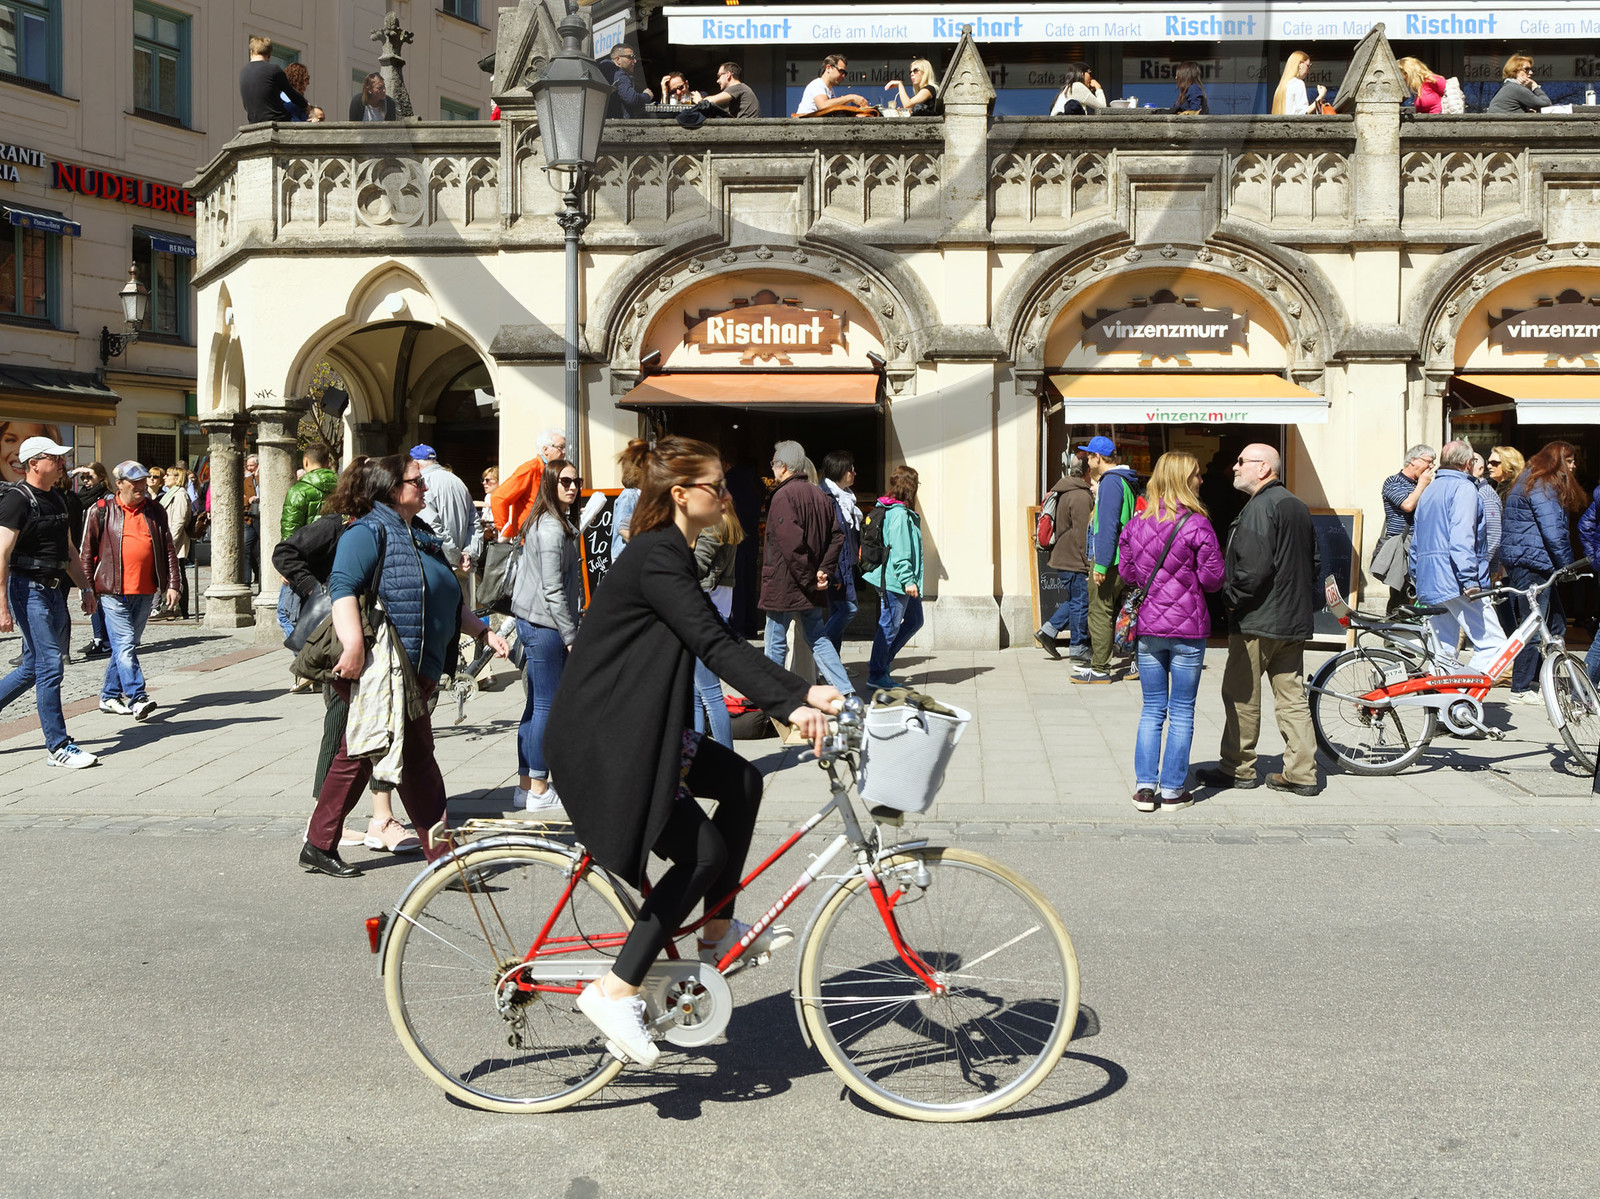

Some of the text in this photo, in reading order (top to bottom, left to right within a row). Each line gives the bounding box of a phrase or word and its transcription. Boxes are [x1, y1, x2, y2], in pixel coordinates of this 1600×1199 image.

[702, 18, 793, 40] Rischart
[846, 28, 866, 38] am
[871, 24, 908, 38] Markt
[1079, 25, 1100, 36] am
[1104, 22, 1142, 36] Markt
[1165, 14, 1257, 36] Rischart
[1317, 24, 1338, 35] am
[1406, 13, 1498, 35] Rischart
[1554, 22, 1575, 34] am
[169, 244, 196, 256] BERNI'S
[706, 316, 824, 345] Rischart
[1102, 320, 1229, 339] vinzenzmurr
[1146, 409, 1248, 422] vinzenzmurr
